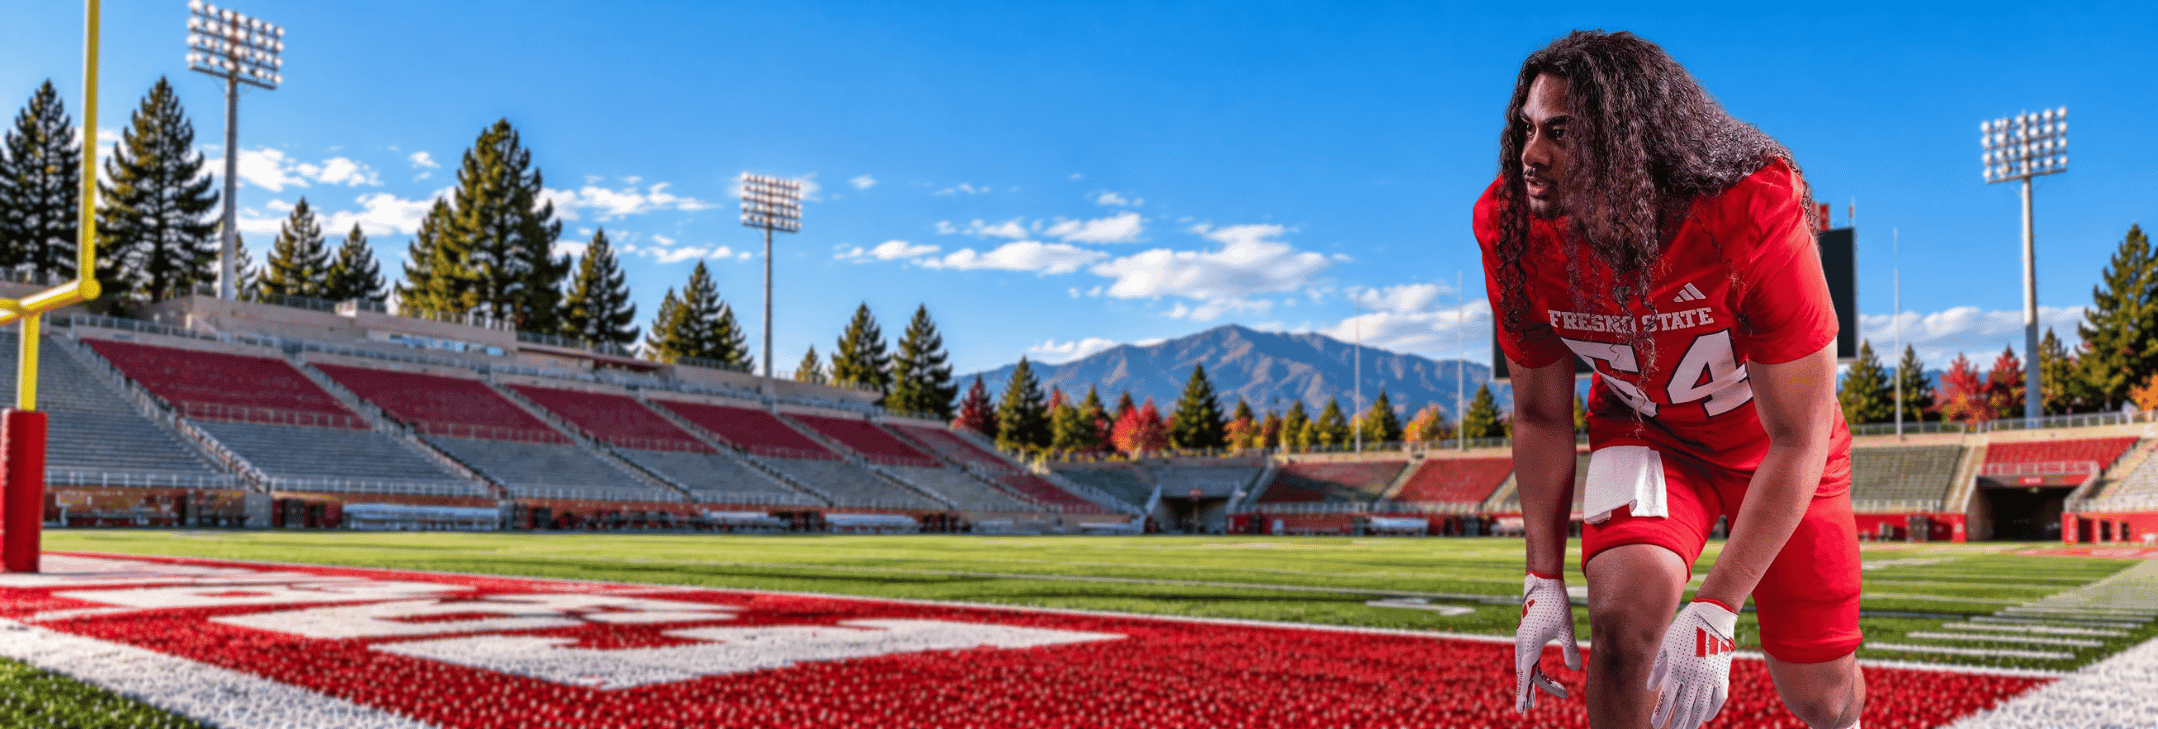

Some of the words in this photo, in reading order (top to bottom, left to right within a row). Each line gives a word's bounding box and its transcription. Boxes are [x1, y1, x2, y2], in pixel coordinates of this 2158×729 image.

[1548, 309, 1637, 334] FRESNO
[1642, 307, 1714, 332] STATE
[1558, 328, 1754, 418] 54
